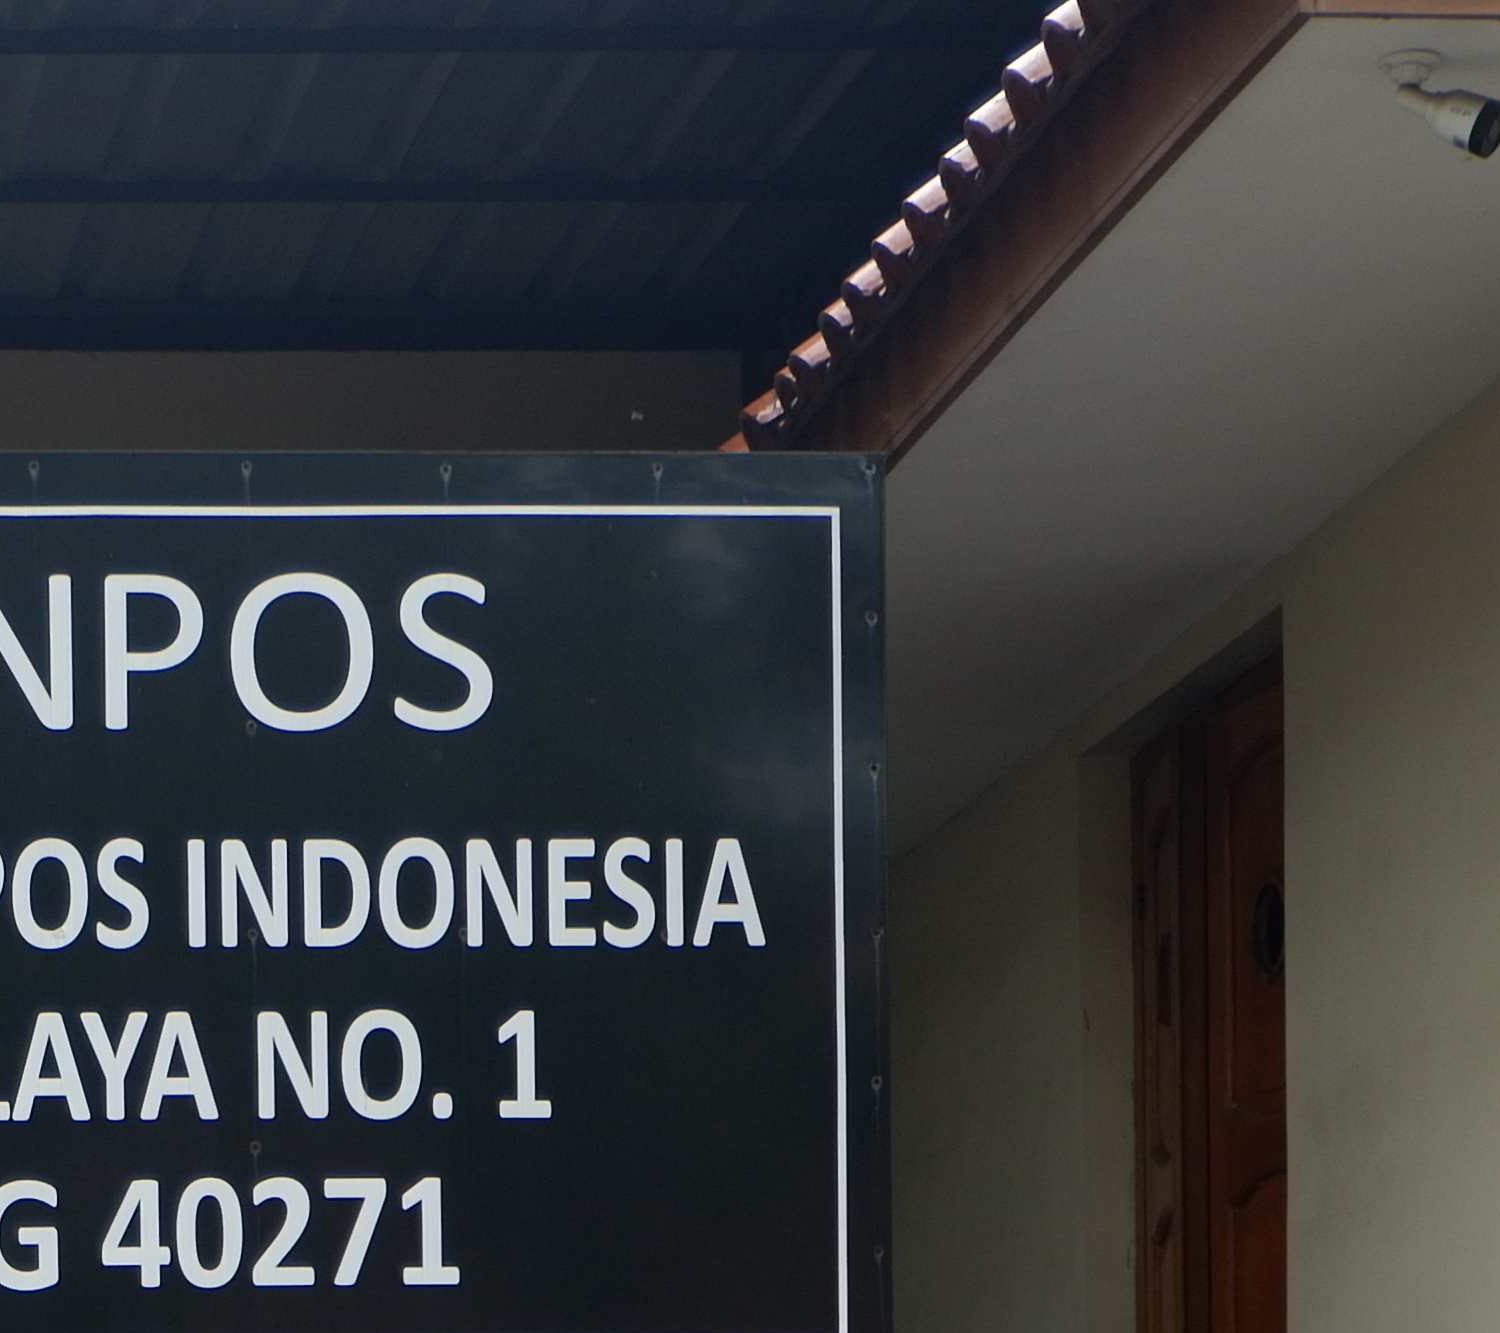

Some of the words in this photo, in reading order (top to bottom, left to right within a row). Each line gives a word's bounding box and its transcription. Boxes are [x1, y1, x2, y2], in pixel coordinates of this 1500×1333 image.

[186, 837, 767, 949] INDONESIA
[257, 1009, 454, 1120] NO.
[498, 1010, 553, 1119] 1
[100, 1176, 461, 1289] 40271
